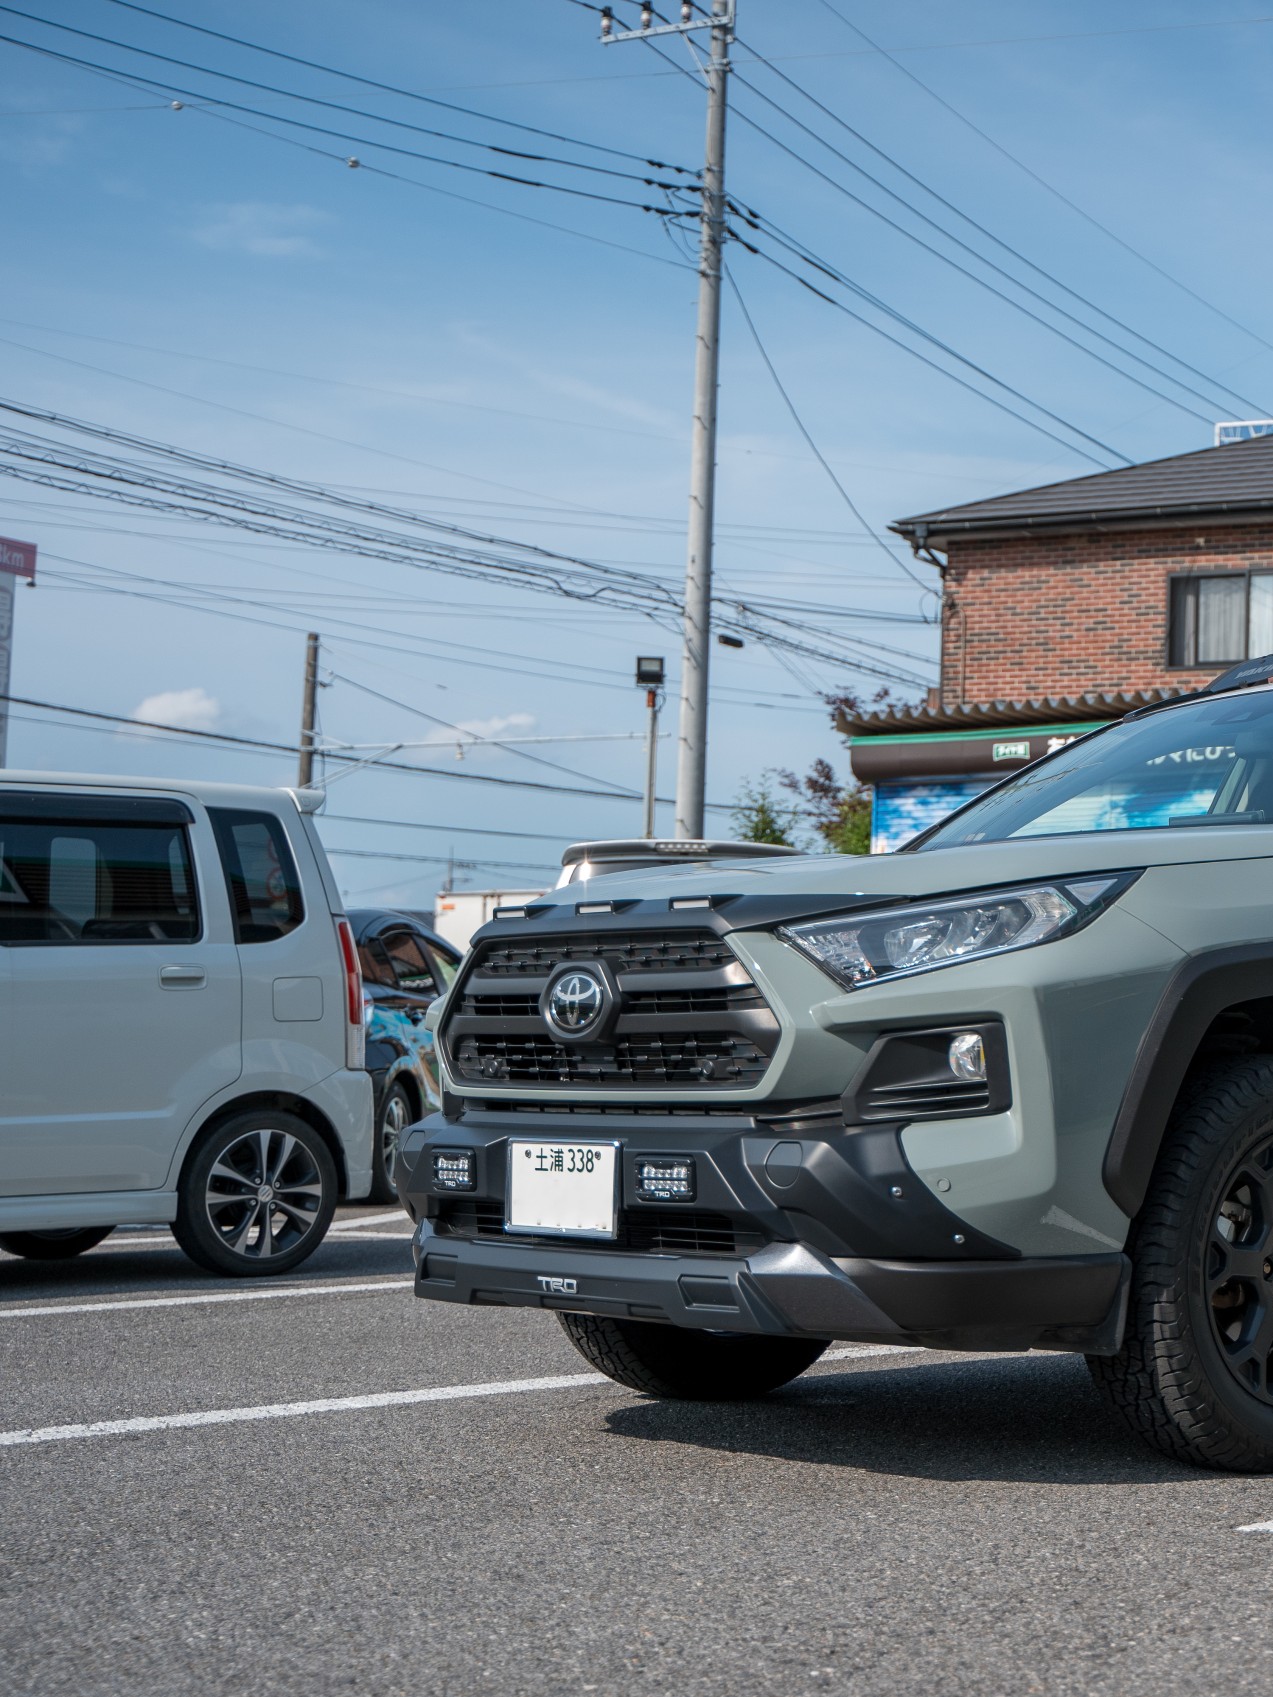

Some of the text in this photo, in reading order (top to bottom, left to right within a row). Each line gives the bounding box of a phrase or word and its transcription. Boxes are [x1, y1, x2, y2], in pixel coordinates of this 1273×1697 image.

[0, 543, 25, 567] km
[654, 1190, 670, 1198] TRD
[537, 1275, 577, 1294] TRD
